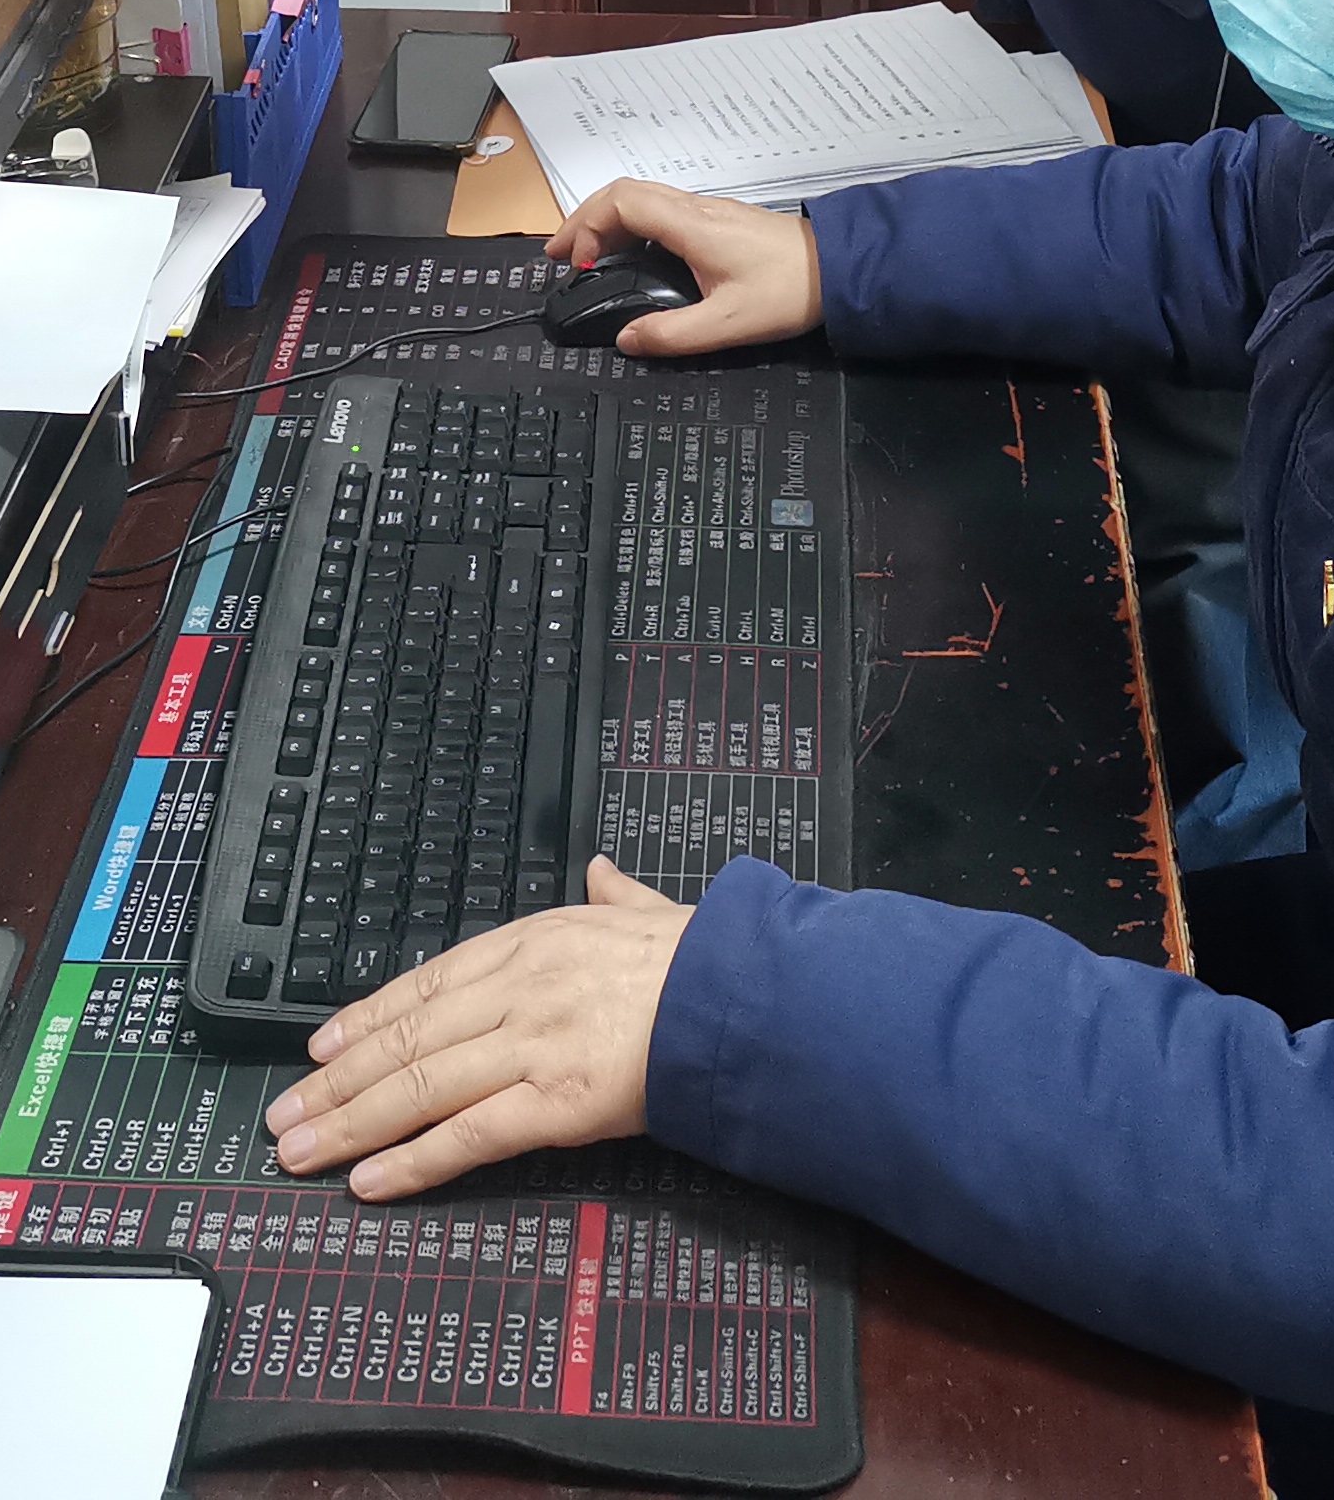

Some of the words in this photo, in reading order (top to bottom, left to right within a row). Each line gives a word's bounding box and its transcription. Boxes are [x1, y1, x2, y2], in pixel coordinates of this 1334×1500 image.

[408, 306, 421, 315] W
[322, 399, 351, 443] Lenovo
[779, 431, 810, 497] Photoshop
[188, 605, 209, 629] 文件
[215, 594, 239, 629] Ctrl+N
[240, 594, 263, 629] Ctrl+O
[214, 644, 230, 653] V
[616, 653, 630, 661] P
[646, 653, 661, 662] T
[679, 654, 693, 662] A
[709, 654, 723, 663] U
[741, 656, 754, 665] H
[772, 658, 785, 667] R
[803, 660, 817, 669] Z
[158, 673, 192, 723] 基本工具
[445, 689, 456, 697] K
[490, 705, 502, 714] M
[182, 709, 212, 752] 移动工具
[485, 735, 498, 743] N
[630, 719, 651, 763] 文字工具
[696, 721, 716, 765] 形状工具
[762, 703, 781, 768] 旋转视图工具
[795, 727, 813, 770] 缩放工具
[386, 751, 398, 759] Y
[436, 747, 448, 755] H
[482, 765, 495, 774] B
[380, 781, 394, 790] T
[477, 797, 491, 805] V
[375, 812, 388, 821] R
[92, 825, 141, 910] Word快捷键
[369, 846, 383, 854] E
[472, 862, 484, 870] X
[363, 877, 377, 889] W
[418, 875, 431, 884] S
[111, 880, 144, 945] Ctrl+Enter
[138, 894, 161, 933] Ctrl+F
[162, 894, 183, 933] Ctrl+1
[413, 909, 426, 919] A
[466, 896, 480, 904] Z
[117, 977, 158, 1044] 向下填充
[149, 977, 186, 1044] 向右填充
[20, 1015, 74, 1117] Excel快捷键
[40, 1119, 73, 1168] Ctrl+1
[83, 1118, 114, 1169] Ctrl+D
[114, 1119, 145, 1171] Ctrl+R
[146, 1121, 176, 1172] Ctrl+E
[177, 1089, 216, 1174] Ctrl+Enter
[21, 1204, 51, 1243] 保存
[51, 1206, 83, 1244] 复制
[83, 1208, 113, 1245] 剪切
[115, 1209, 143, 1246] 粘贴
[198, 1212, 226, 1251] 撤销
[229, 1214, 256, 1253] 恢复
[261, 1215, 289, 1253] 全选
[292, 1216, 321, 1254] 查找
[353, 1219, 381, 1256] 新建
[385, 1219, 411, 1258] 打印
[418, 1220, 444, 1259] 居中
[450, 1222, 476, 1260] 加粗
[482, 1224, 507, 1261] 倾斜
[512, 1216, 539, 1272] 下划线
[543, 1218, 571, 1276] 超链接
[232, 1303, 266, 1375] Ctrl+A
[264, 1308, 296, 1376] Ctrl+F
[297, 1306, 330, 1377] Ctrl+H
[330, 1307, 363, 1378] Ctrl+N
[364, 1310, 394, 1380] Ctrl+P
[398, 1313, 427, 1382] Ctrl+E
[431, 1312, 460, 1383] Ctrl+B
[498, 1313, 526, 1386] Ctrl+U
[531, 1317, 559, 1388] Ctrl+K
[571, 1322, 591, 1363] PPT
[621, 1363, 636, 1409] Alt+F9
[695, 1368, 710, 1413] Ctrl+K
[745, 1329, 759, 1415] Ctrl+Shift+C
[596, 1391, 609, 1409] F4
